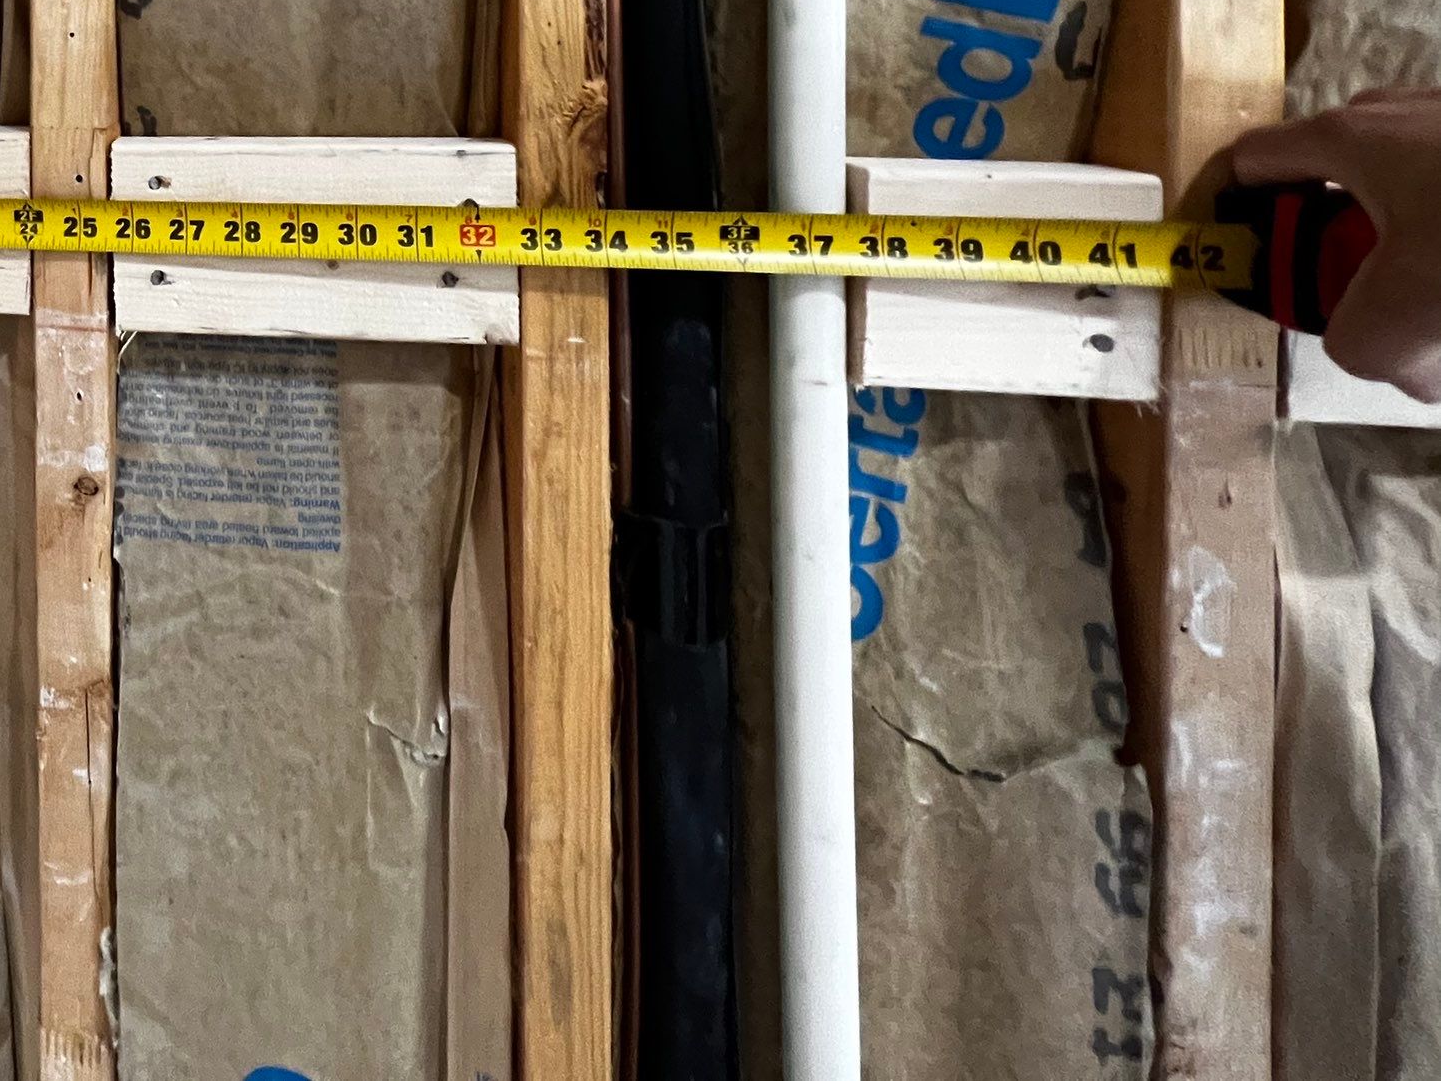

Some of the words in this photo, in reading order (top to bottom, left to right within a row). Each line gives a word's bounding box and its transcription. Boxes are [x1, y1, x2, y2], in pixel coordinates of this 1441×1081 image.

[18, 210, 38, 223] 2F
[726, 226, 753, 240] 3F
[19, 222, 39, 236] 24
[63, 216, 98, 239] 25
[115, 218, 152, 240] 26
[168, 219, 206, 242] 27
[223, 220, 262, 243] 28
[279, 221, 319, 245] 29
[338, 222, 378, 247] 30
[396, 224, 435, 248] 31
[461, 225, 494, 246] 32
[520, 227, 563, 252] 33
[584, 229, 629, 253] 34
[650, 231, 696, 256] 35
[727, 240, 754, 256] 36
[787, 234, 834, 257] 37
[859, 236, 909, 260] 38
[933, 237, 984, 263] 39
[1009, 240, 1063, 266] 40
[1088, 242, 1139, 269] 41
[1170, 245, 1226, 272] 42
[291, 497, 341, 511] Warning:
[123, 526, 158, 541] should
[263, 526, 299, 537] toward
[238, 536, 270, 550] Vapor
[273, 539, 341, 552] Application:
